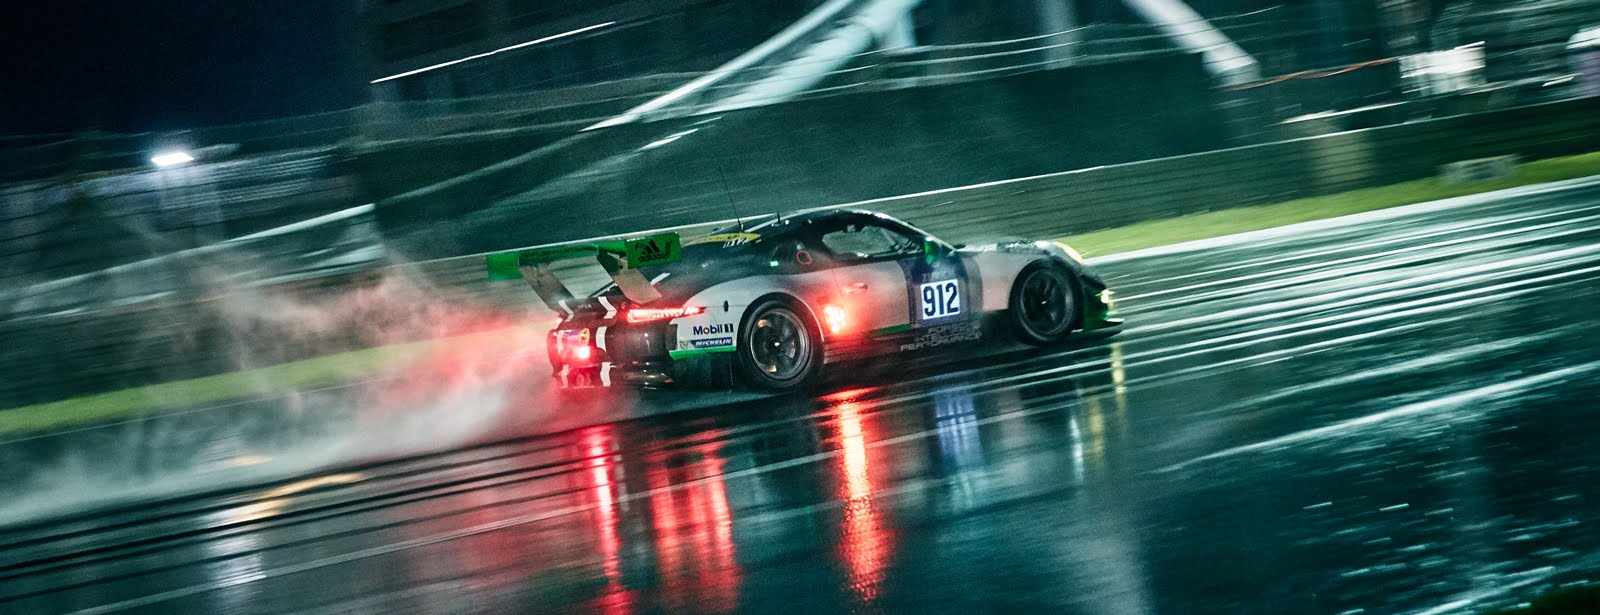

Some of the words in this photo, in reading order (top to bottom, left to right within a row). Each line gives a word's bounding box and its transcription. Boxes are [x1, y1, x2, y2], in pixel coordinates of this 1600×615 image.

[923, 282, 959, 317] 912
[693, 324, 722, 335] Mobil
[724, 323, 734, 333] 1
[695, 338, 731, 347] MICHELIN
